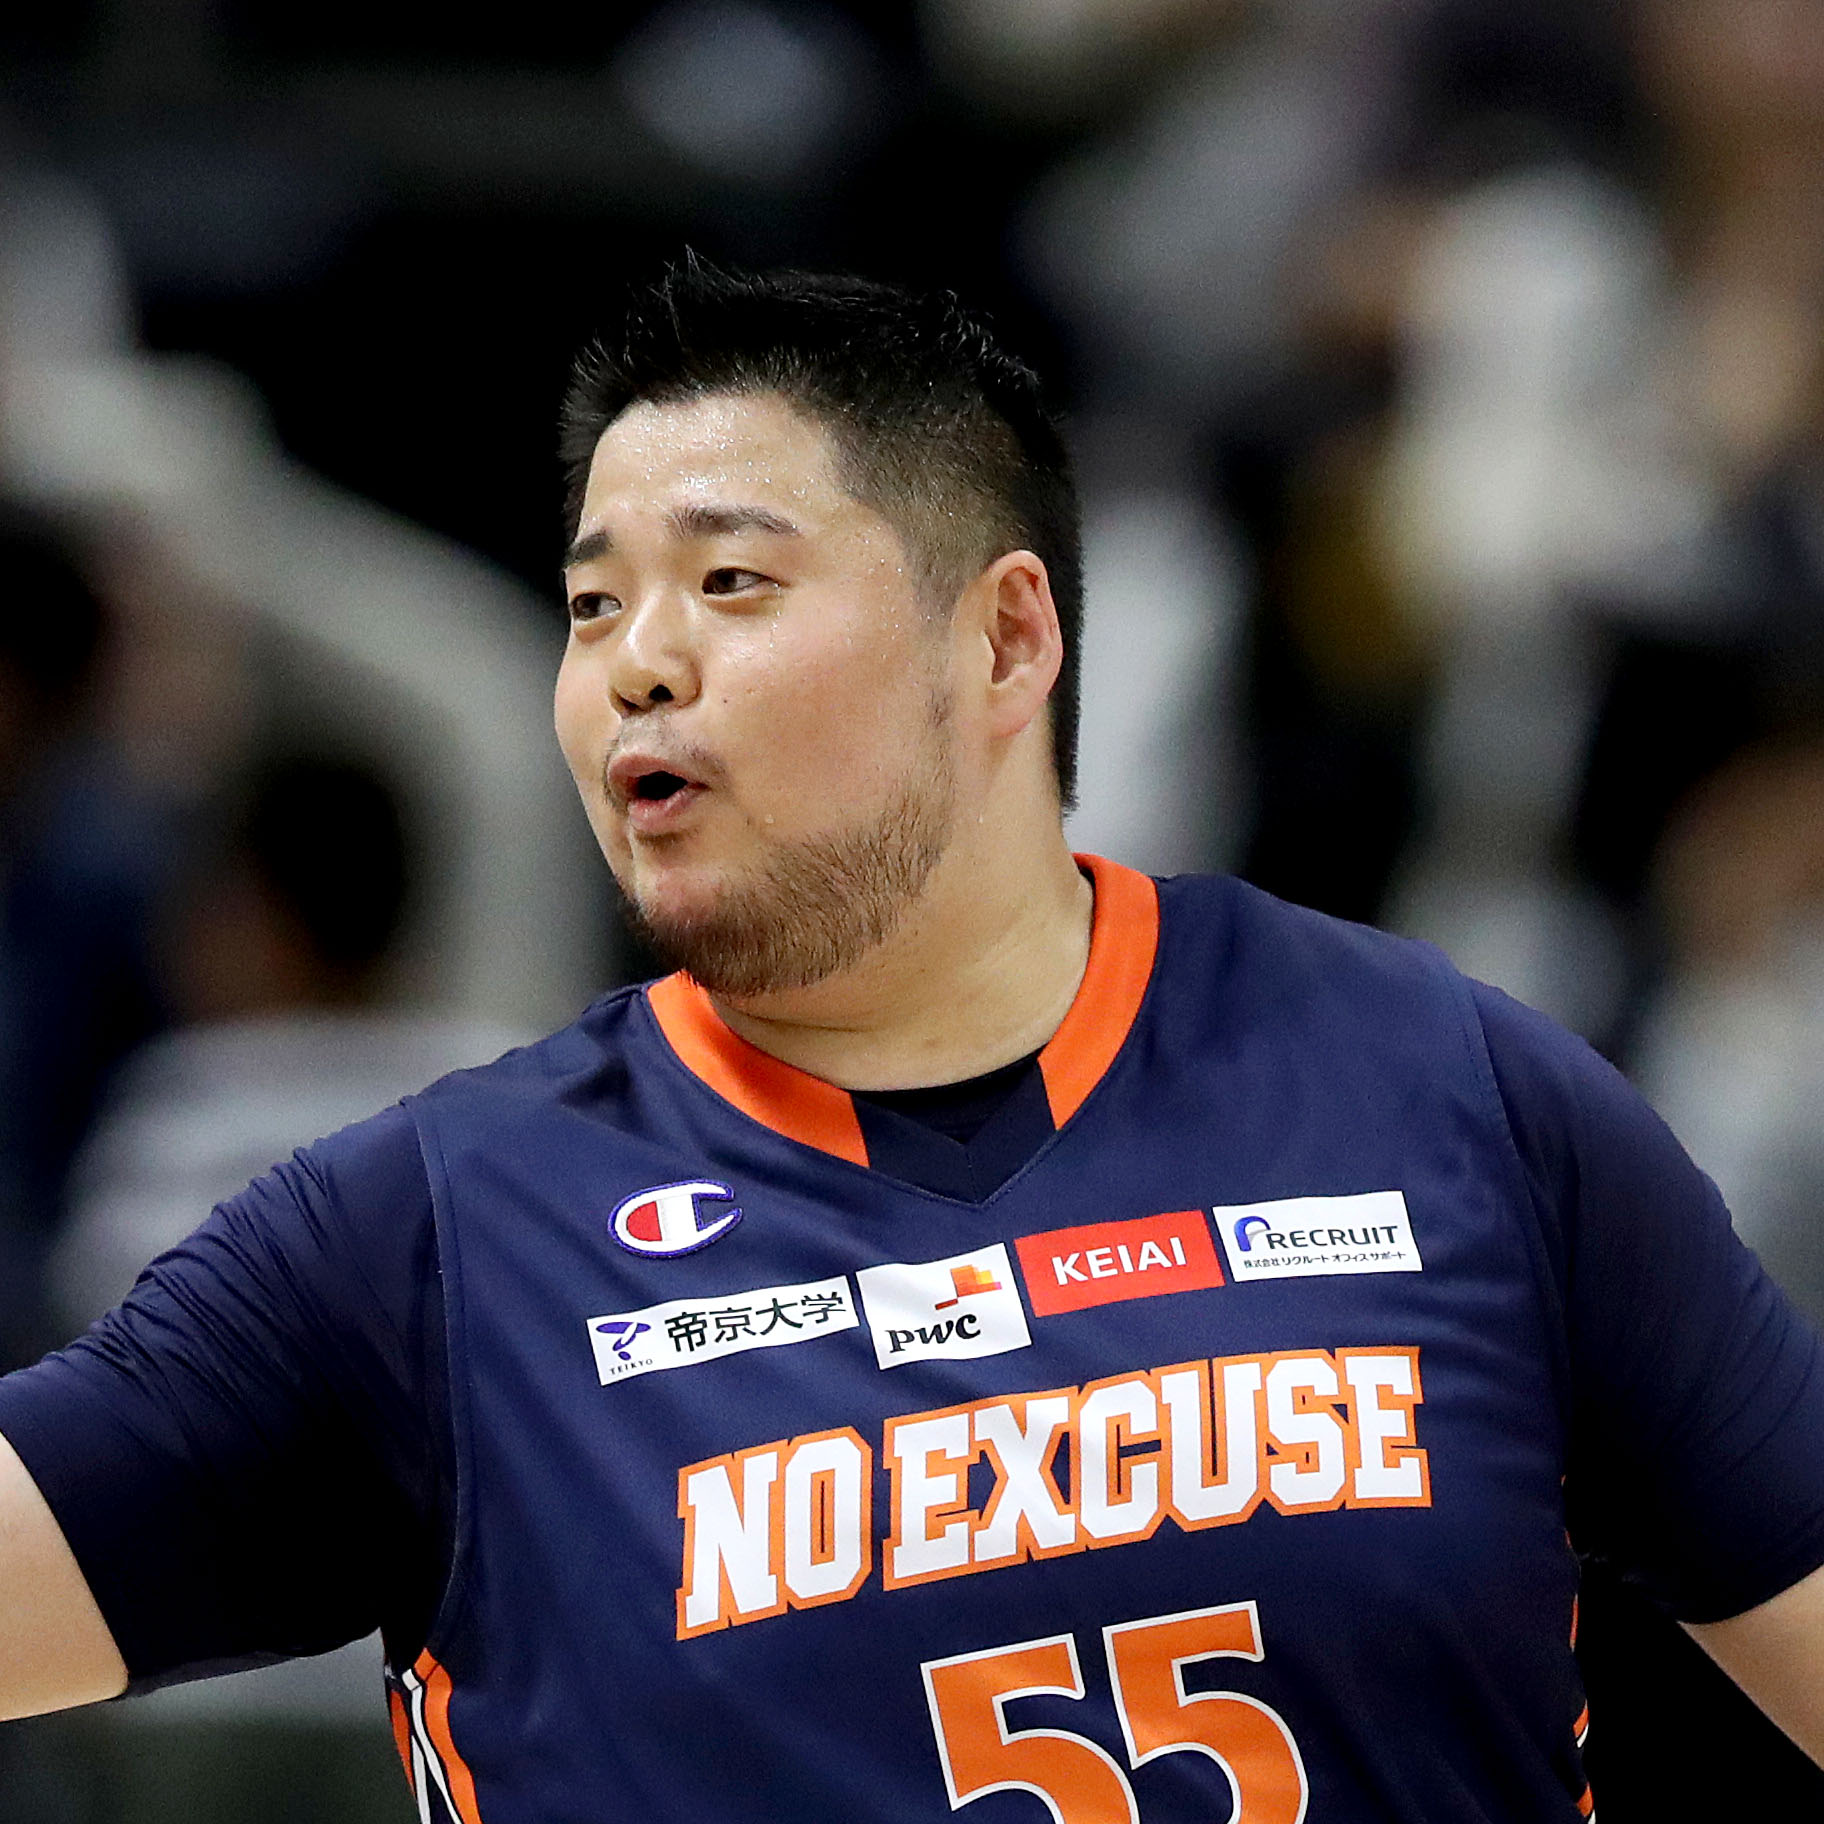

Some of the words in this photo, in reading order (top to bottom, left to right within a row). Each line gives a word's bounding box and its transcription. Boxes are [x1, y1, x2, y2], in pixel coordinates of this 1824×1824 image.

[1051, 1237, 1188, 1286] KEIAI
[1266, 1225, 1398, 1250] RECRUIT
[665, 1291, 846, 1353] 帝京大学
[609, 1358, 653, 1375] TEIKYO
[676, 1425, 873, 1641] NO
[882, 1345, 1434, 1592] EXCUSE
